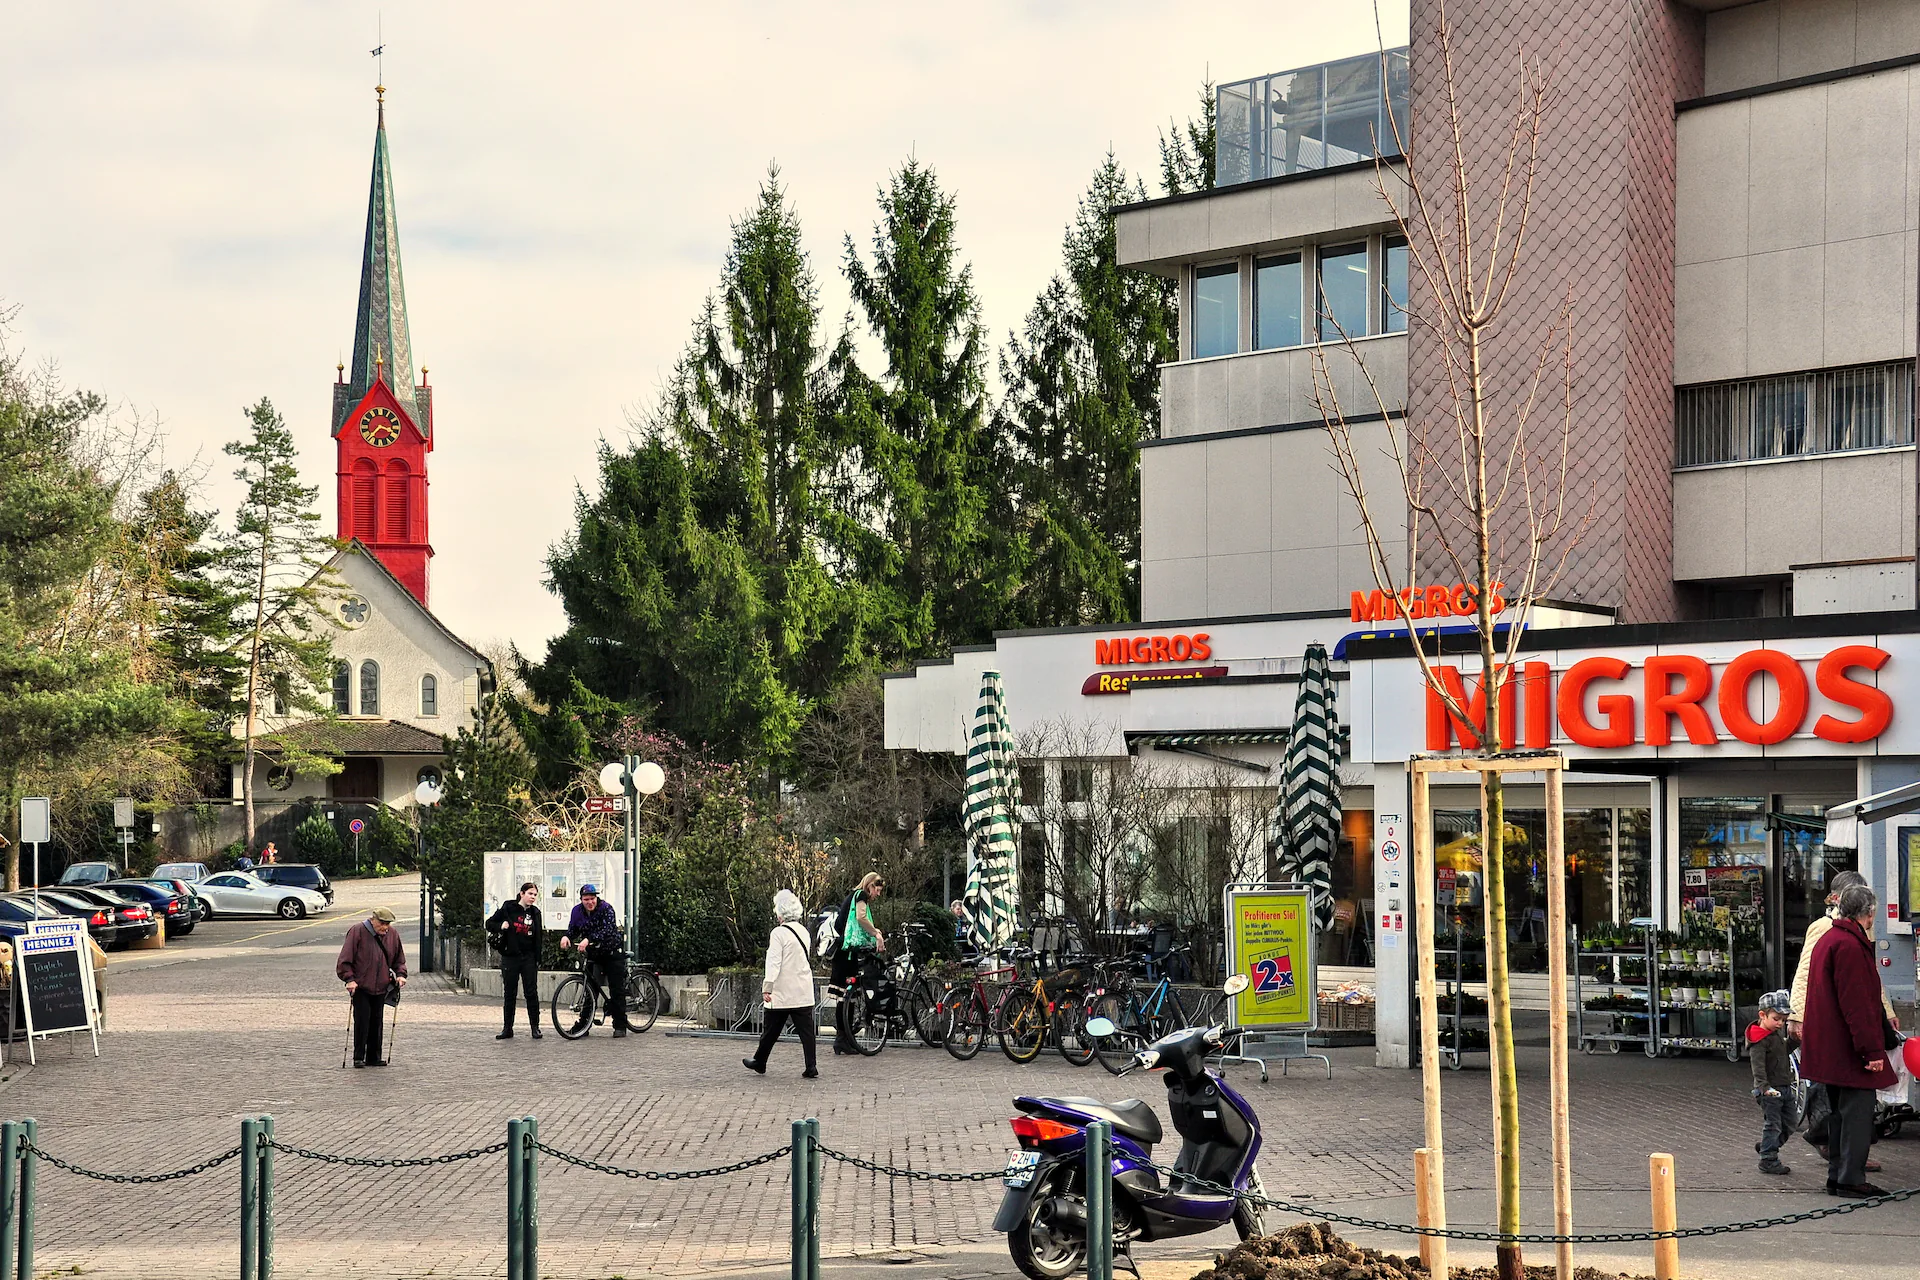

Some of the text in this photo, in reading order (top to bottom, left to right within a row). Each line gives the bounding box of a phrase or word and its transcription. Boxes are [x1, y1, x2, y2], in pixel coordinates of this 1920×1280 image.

[1096, 633, 1212, 665] MIGROS
[1426, 645, 1894, 751] MIGROS
[1686, 875, 1701, 884] 7.80
[1244, 909, 1296, 920] Profitieren Sie!
[37, 925, 78, 933] HENNIEZ
[26, 938, 72, 950] HENNIEZ
[1258, 950, 1280, 961] BONUS
[1018, 1152, 1031, 1165] ZH
